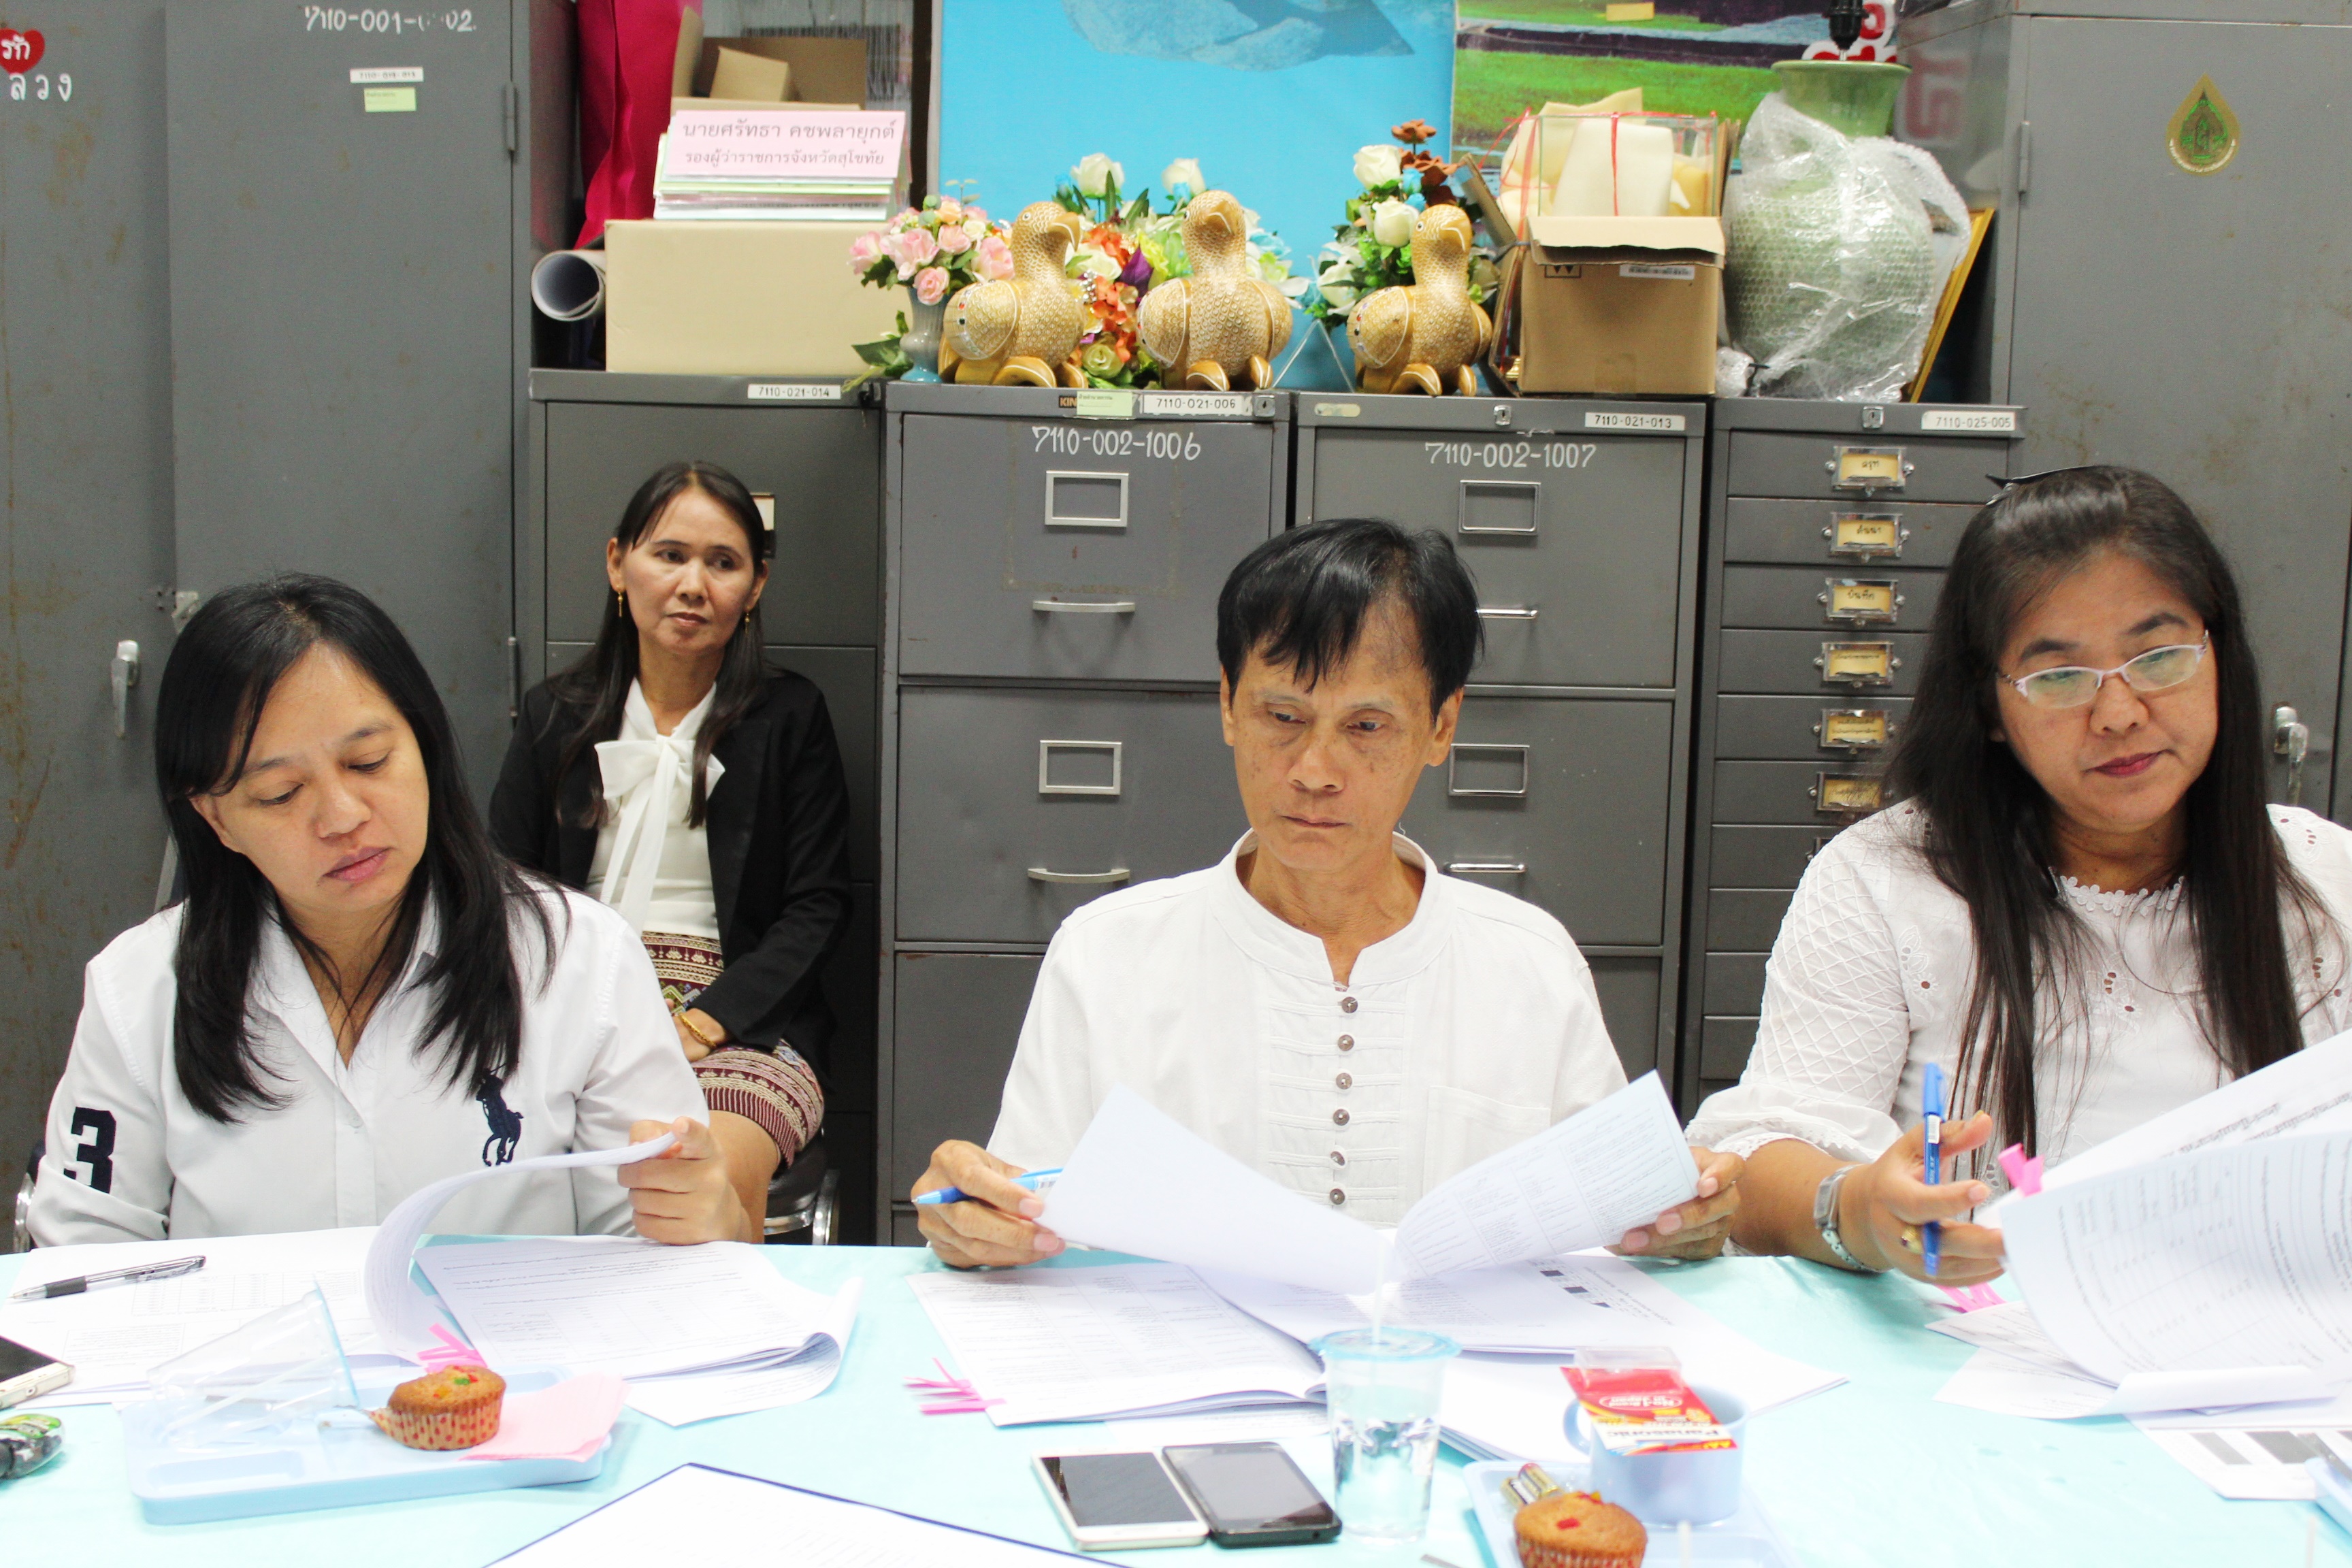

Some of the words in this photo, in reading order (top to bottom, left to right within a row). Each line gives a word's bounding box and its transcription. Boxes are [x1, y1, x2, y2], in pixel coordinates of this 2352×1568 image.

[1, 34, 31, 60] รัก
[759, 387, 830, 397] 7110-021-014
[1156, 398, 1236, 409] 7110-021-006
[1595, 415, 1671, 428] 7110-021-013
[1936, 416, 2011, 428] 7110-025-005
[1032, 426, 1201, 461] 7110-002-1006
[1424, 442, 1597, 468] 7110-002-1007
[64, 1107, 116, 1194] 3
[1607, 1429, 1720, 1438] Panasonic
